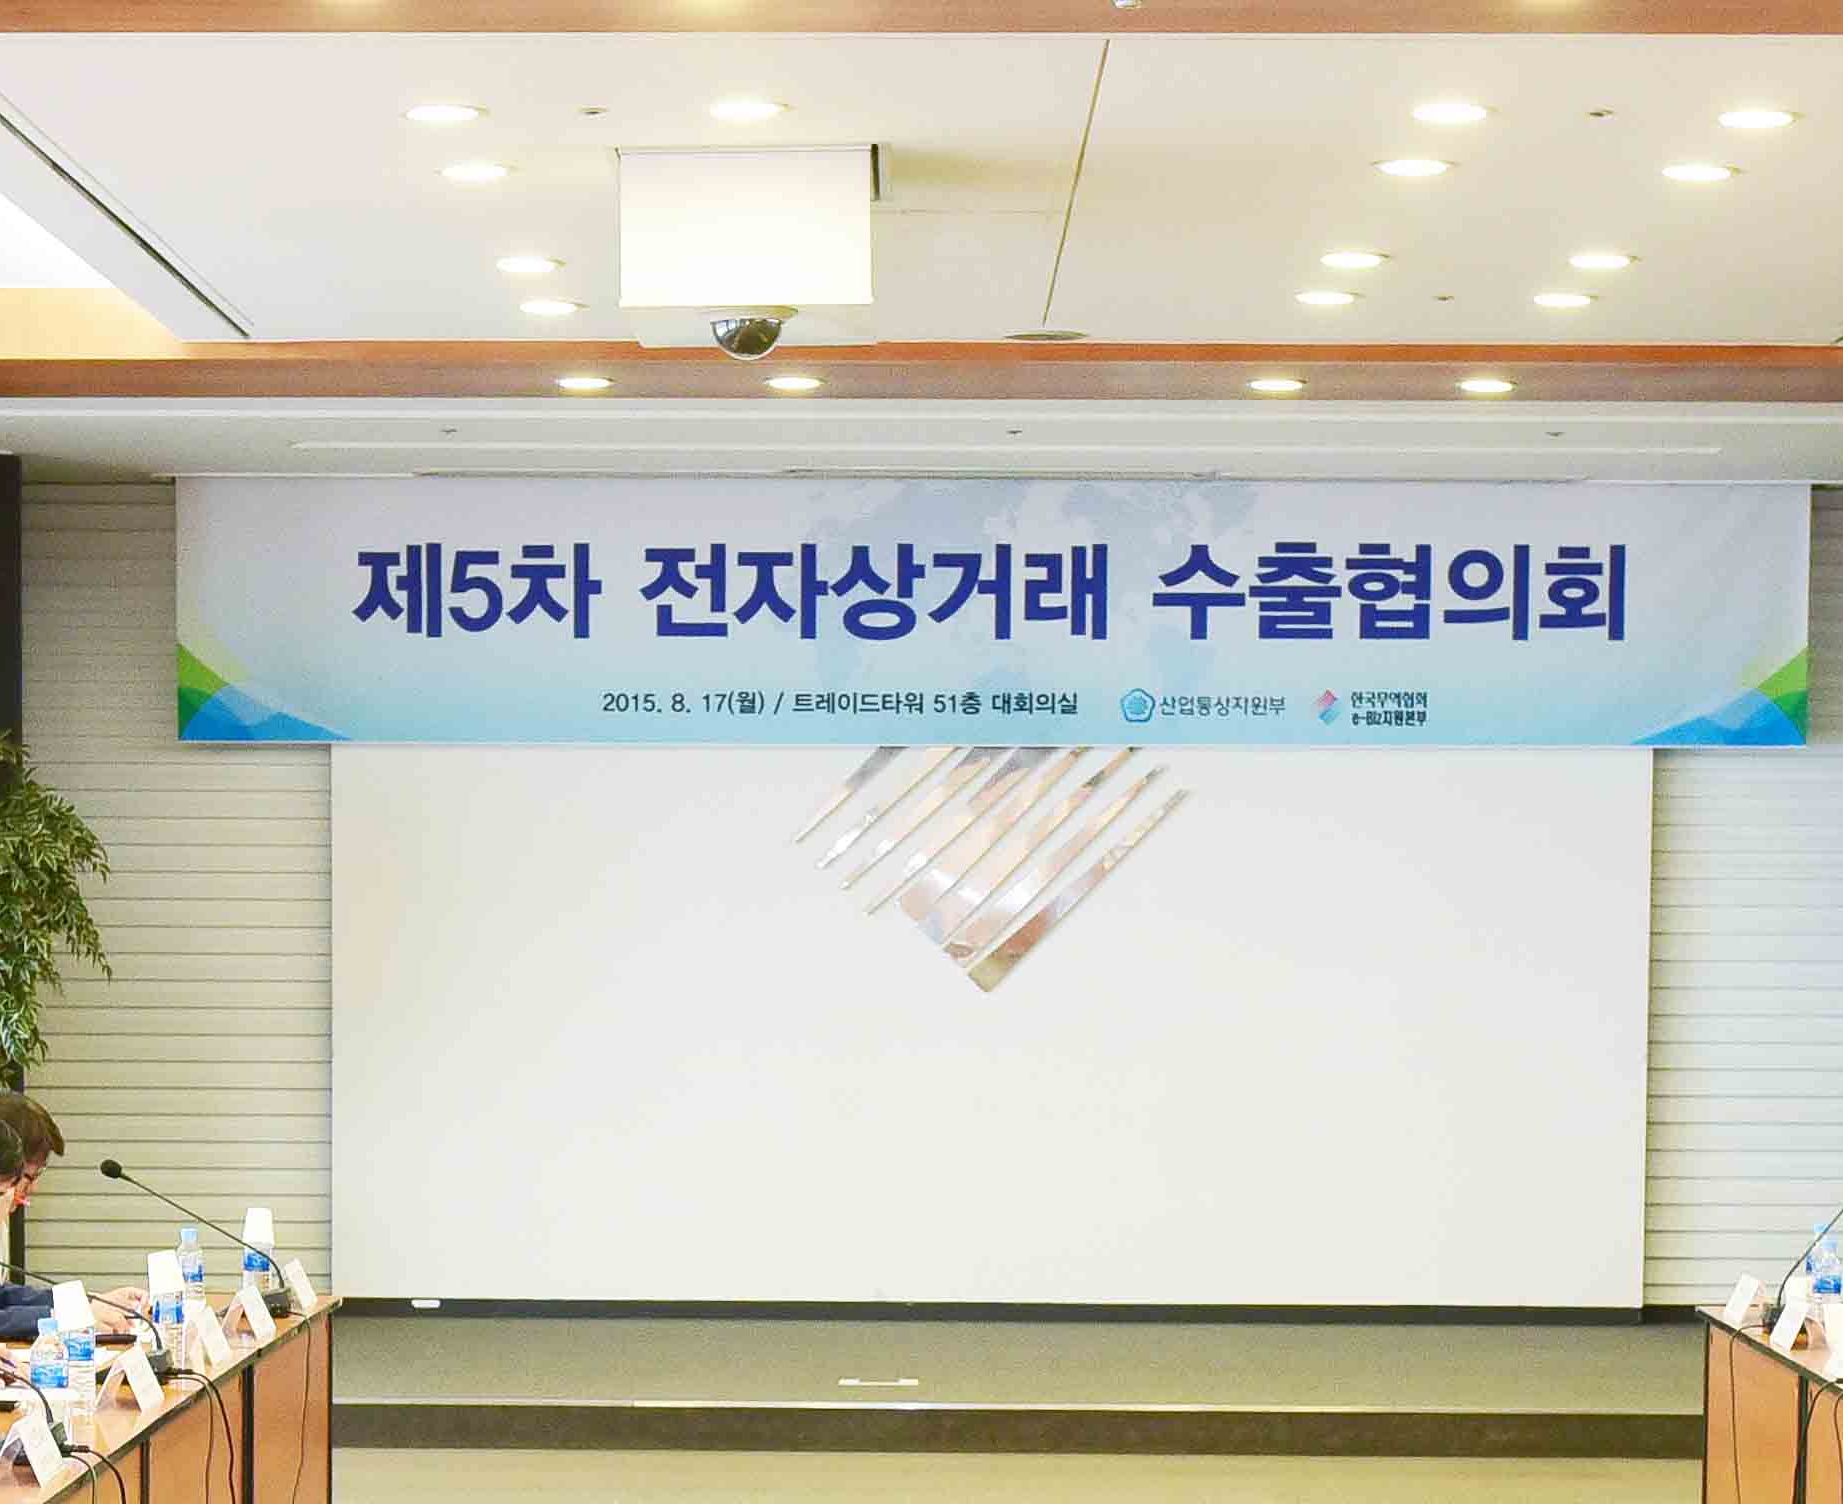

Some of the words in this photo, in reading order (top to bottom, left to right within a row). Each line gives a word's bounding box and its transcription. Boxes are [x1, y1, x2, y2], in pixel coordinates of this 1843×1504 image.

[353, 543, 601, 638] 제5차
[641, 544, 1107, 640] 전자상거래
[1153, 543, 1625, 640] 수출협의회
[604, 693, 661, 713] 2015.
[671, 693, 691, 713] 8.
[703, 692, 764, 714] 17(월)
[774, 692, 784, 714] /
[792, 692, 924, 715] 트레이드타워
[934, 692, 981, 715] 51층
[992, 692, 1078, 715] 대회의실
[1159, 695, 1286, 717] 산업통상자원부
